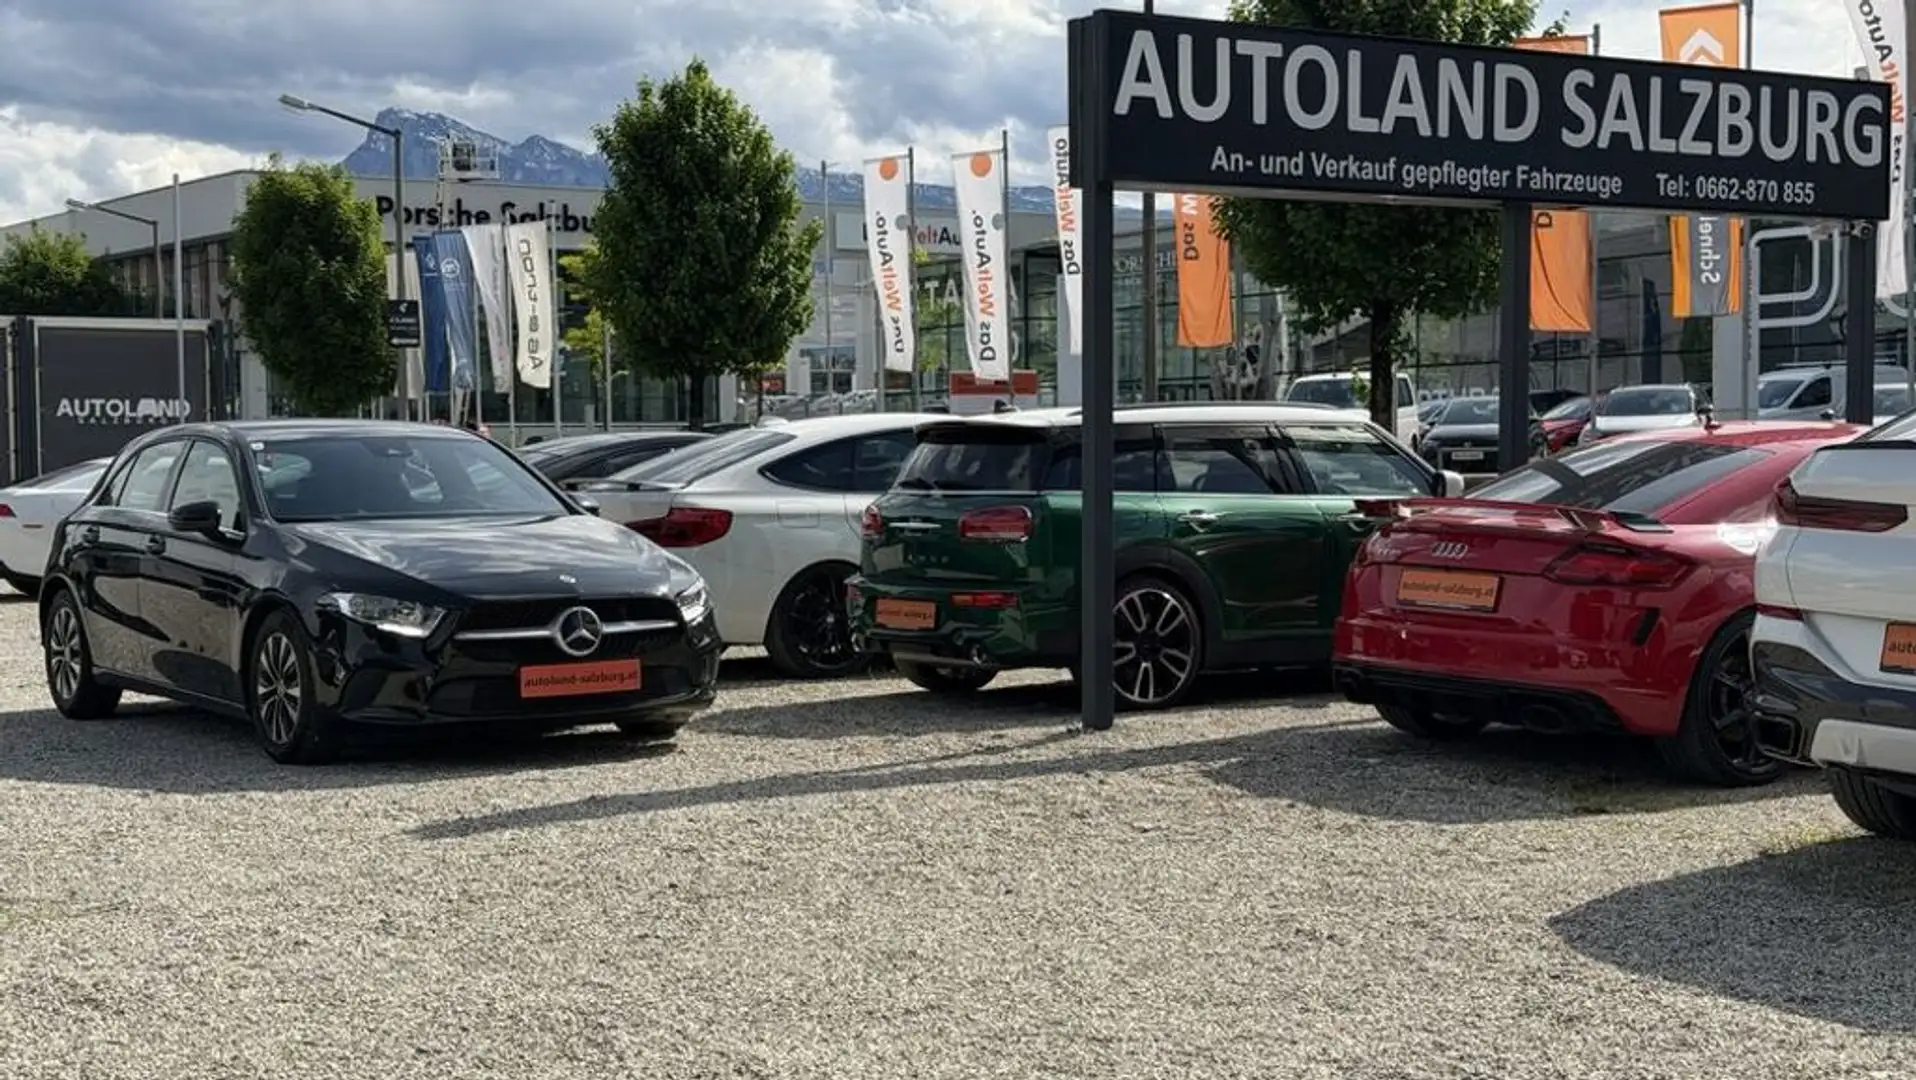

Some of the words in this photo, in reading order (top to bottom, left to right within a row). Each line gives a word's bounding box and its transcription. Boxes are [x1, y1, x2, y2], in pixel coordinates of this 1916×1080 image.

[1113, 30, 1540, 142] AUTOLAND
[1561, 68, 1884, 168] SALZBURG
[1211, 146, 1252, 172] An-
[1260, 152, 1304, 176] und
[1310, 151, 1396, 181] Verkauf
[1402, 160, 1510, 192] gepflegter
[1516, 165, 1622, 198] Fahrzeuge
[1656, 173, 1690, 197] Tel:
[1696, 176, 1778, 202] 0662-870
[1783, 182, 1816, 204] 855
[56, 397, 192, 418] AUTOLAND
